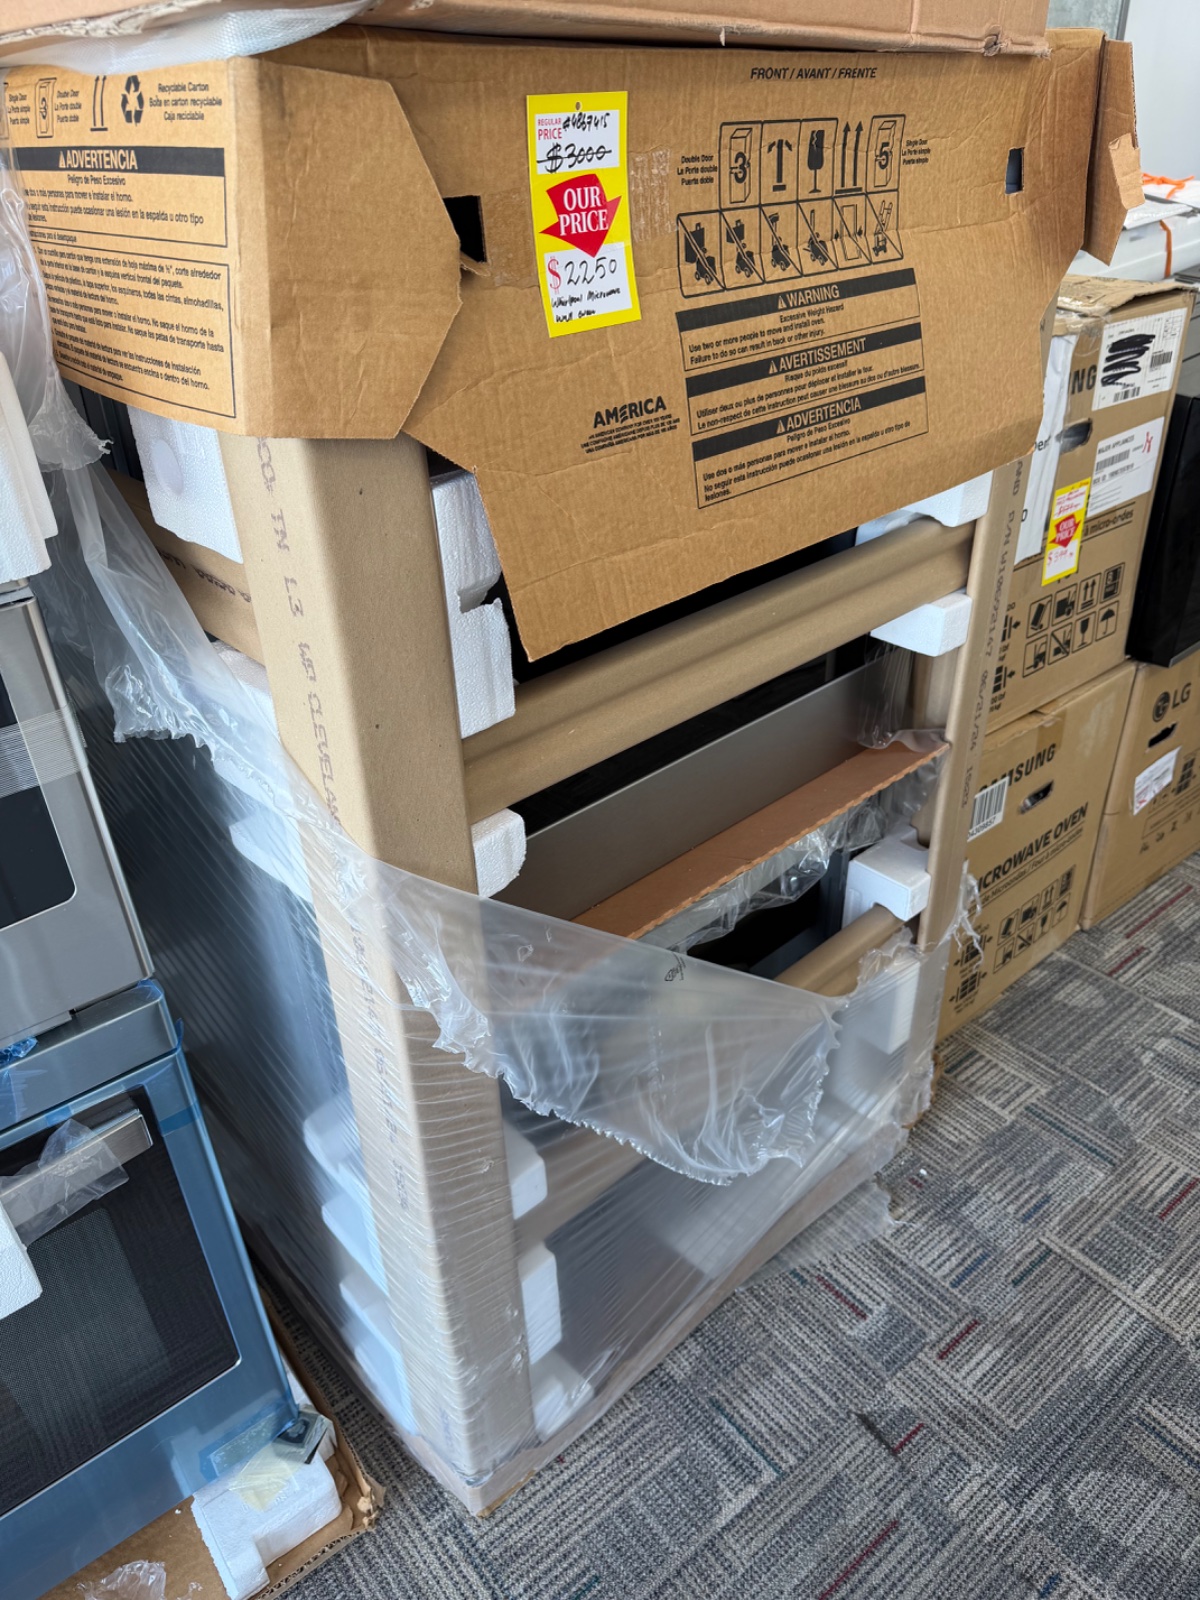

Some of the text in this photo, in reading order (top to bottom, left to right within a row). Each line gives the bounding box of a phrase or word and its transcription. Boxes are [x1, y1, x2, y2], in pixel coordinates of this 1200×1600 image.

[751, 67, 878, 79] FRONT AVANT FRENTE
[158, 81, 209, 95] Recyclable Carton
[163, 98, 171, 107] en
[171, 97, 189, 107] carton
[189, 96, 223, 109] recyclable
[163, 111, 205, 122] Caja reciclable
[537, 118, 562, 127] REGULAR
[537, 128, 563, 140] PRICE
[65, 149, 138, 170] ADVERTENCIA
[545, 143, 607, 174] $3000
[681, 153, 714, 164] Double Door
[734, 152, 747, 184] 3
[67, 173, 126, 185] Peligro de Peso Excesivo
[677, 163, 718, 176] La Porte double
[681, 174, 714, 186] Puerta doble
[92, 191, 115, 201] instalar el
[563, 185, 601, 211] OUR
[115, 207, 131, 218] lesión
[139, 209, 144, 219] la
[145, 210, 168, 223] espalda
[174, 213, 188, 223] otro
[189, 213, 204, 226] tipo
[559, 209, 609, 237] PRICE
[175, 266, 221, 281] corte alrededor
[183, 295, 223, 312] almohadillas,
[786, 283, 840, 307] WARNING
[779, 302, 844, 323] Excessive Weight Hazard
[199, 326, 214, 337] de la
[688, 317, 824, 353] Use two or more people to move and install oven.
[176, 336, 205, 350] transporte
[206, 342, 223, 352] hasta
[689, 352, 711, 364] Failure
[712, 351, 718, 359] to
[719, 348, 727, 358] do
[737, 346, 747, 354] can
[749, 340, 765, 351] result
[765, 338, 771, 347] in
[772, 335, 785, 345] back
[793, 330, 808, 340] other
[808, 326, 824, 338] injury.
[778, 337, 866, 372] AVERTISSEMENT
[170, 360, 201, 375] instalación
[804, 368, 811, 377] du
[811, 364, 826, 376] poids
[827, 359, 847, 371] excessif
[180, 376, 189, 385] del
[696, 405, 718, 418] Utiliser
[718, 400, 733, 412] deux
[734, 400, 742, 408] ou
[743, 395, 755, 407] plus
[756, 393, 763, 402] de
[764, 386, 793, 401] personnes
[794, 383, 807, 393] pour
[593, 395, 667, 429] AMERICA
[697, 420, 705, 430] Le
[767, 395, 795, 410] instruction
[785, 396, 861, 431] ADVERTENCIA
[786, 416, 850, 443] Peligro de Peso Excesivo
[702, 433, 833, 481] Use dos más personas para mover instalar el
[703, 483, 713, 492] No
[714, 476, 732, 490] seguir
[733, 473, 745, 483] esta
[746, 462, 777, 479] instrucción
[778, 456, 795, 469] puede
[796, 448, 821, 462] ocasionar
[704, 486, 731, 501] lesiones.
[1171, 682, 1192, 710] LG
[306, 692, 343, 828] CLEVELAN
[978, 828, 1052, 892] ICROWAVE
[1053, 801, 1089, 841] OVEN
